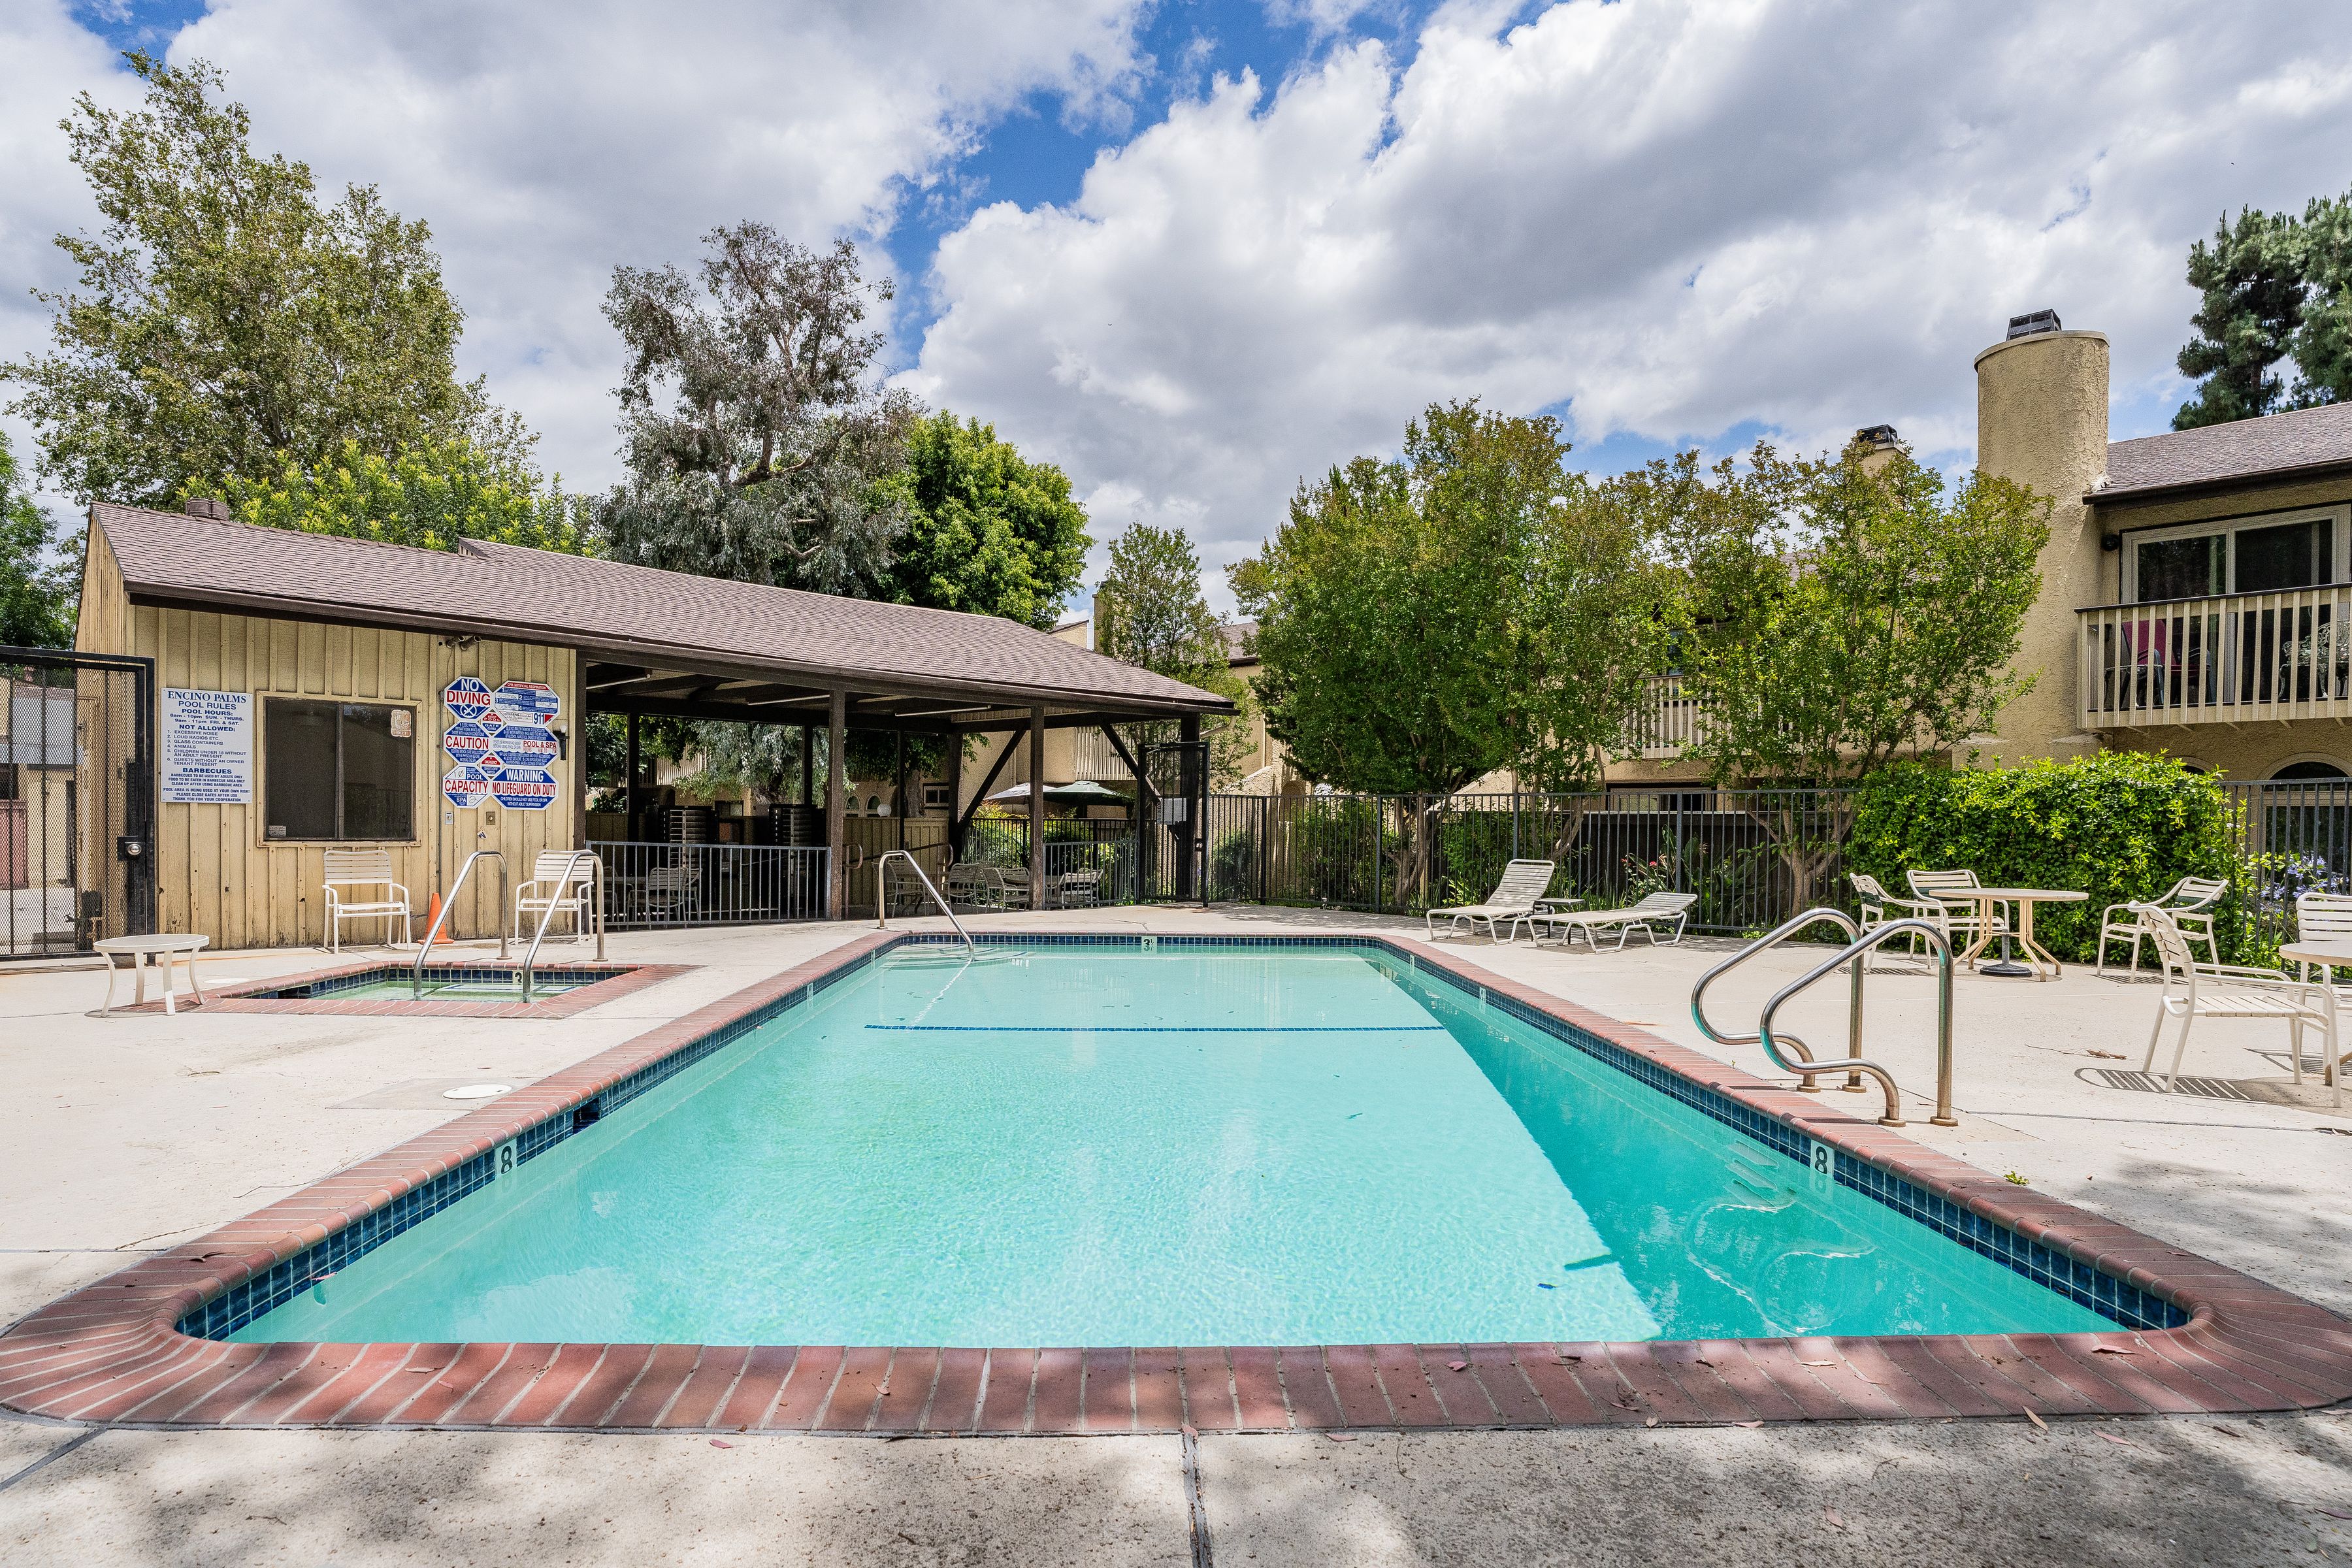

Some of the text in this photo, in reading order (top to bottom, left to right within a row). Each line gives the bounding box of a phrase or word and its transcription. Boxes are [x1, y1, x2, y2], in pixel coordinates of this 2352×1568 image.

[461, 679, 479, 691] NO
[168, 691, 246, 704] ENCINO PALMS
[447, 691, 491, 706] DIVING
[534, 713, 544, 725] 911
[446, 736, 489, 749] CAUTION
[506, 769, 544, 782] WARNING
[445, 780, 488, 793] CAPACITY
[493, 782, 556, 795] NO LIFEGUARD ON DUTY
[500, 1145, 513, 1175] 8
[1814, 1146, 1828, 1175] 8
